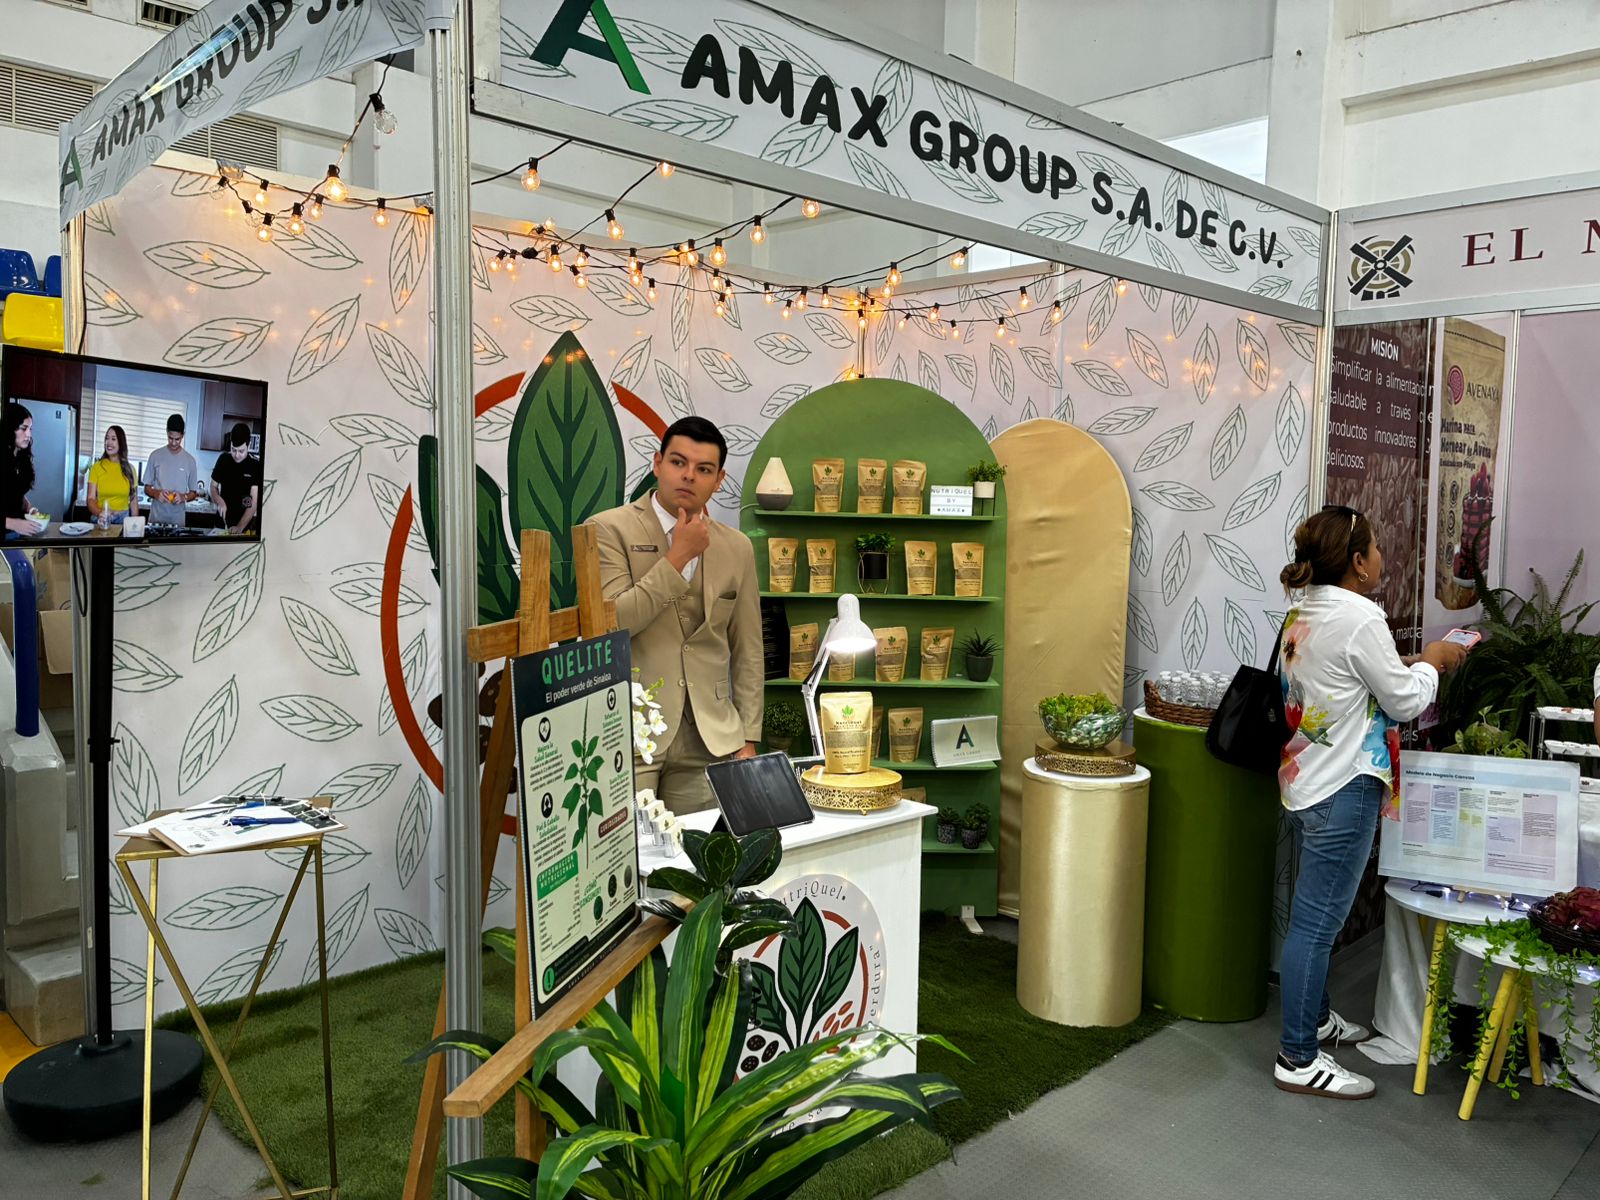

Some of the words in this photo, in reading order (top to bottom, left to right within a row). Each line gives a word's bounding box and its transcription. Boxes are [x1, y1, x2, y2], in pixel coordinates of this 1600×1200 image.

[91, 75, 166, 169] AMAX
[173, 0, 294, 109] GROUP
[681, 34, 888, 147] AMAX
[910, 110, 1077, 200] GROUP
[1092, 171, 1164, 232] S.A.
[1176, 199, 1219, 248] DE
[1229, 219, 1284, 269] C.V.
[1461, 231, 1544, 268] EL
[1370, 336, 1400, 362] MISIÓN
[1375, 367, 1383, 385] la
[1376, 401, 1382, 414] a
[1390, 402, 1412, 421] través
[1327, 419, 1368, 441] productos
[1374, 425, 1417, 449] innovadores
[541, 639, 613, 685] QUELITE
[545, 691, 553, 703] El
[553, 686, 571, 703] poder
[570, 680, 586, 694] verde
[586, 678, 593, 688] de
[593, 672, 612, 686] Sinaloa
